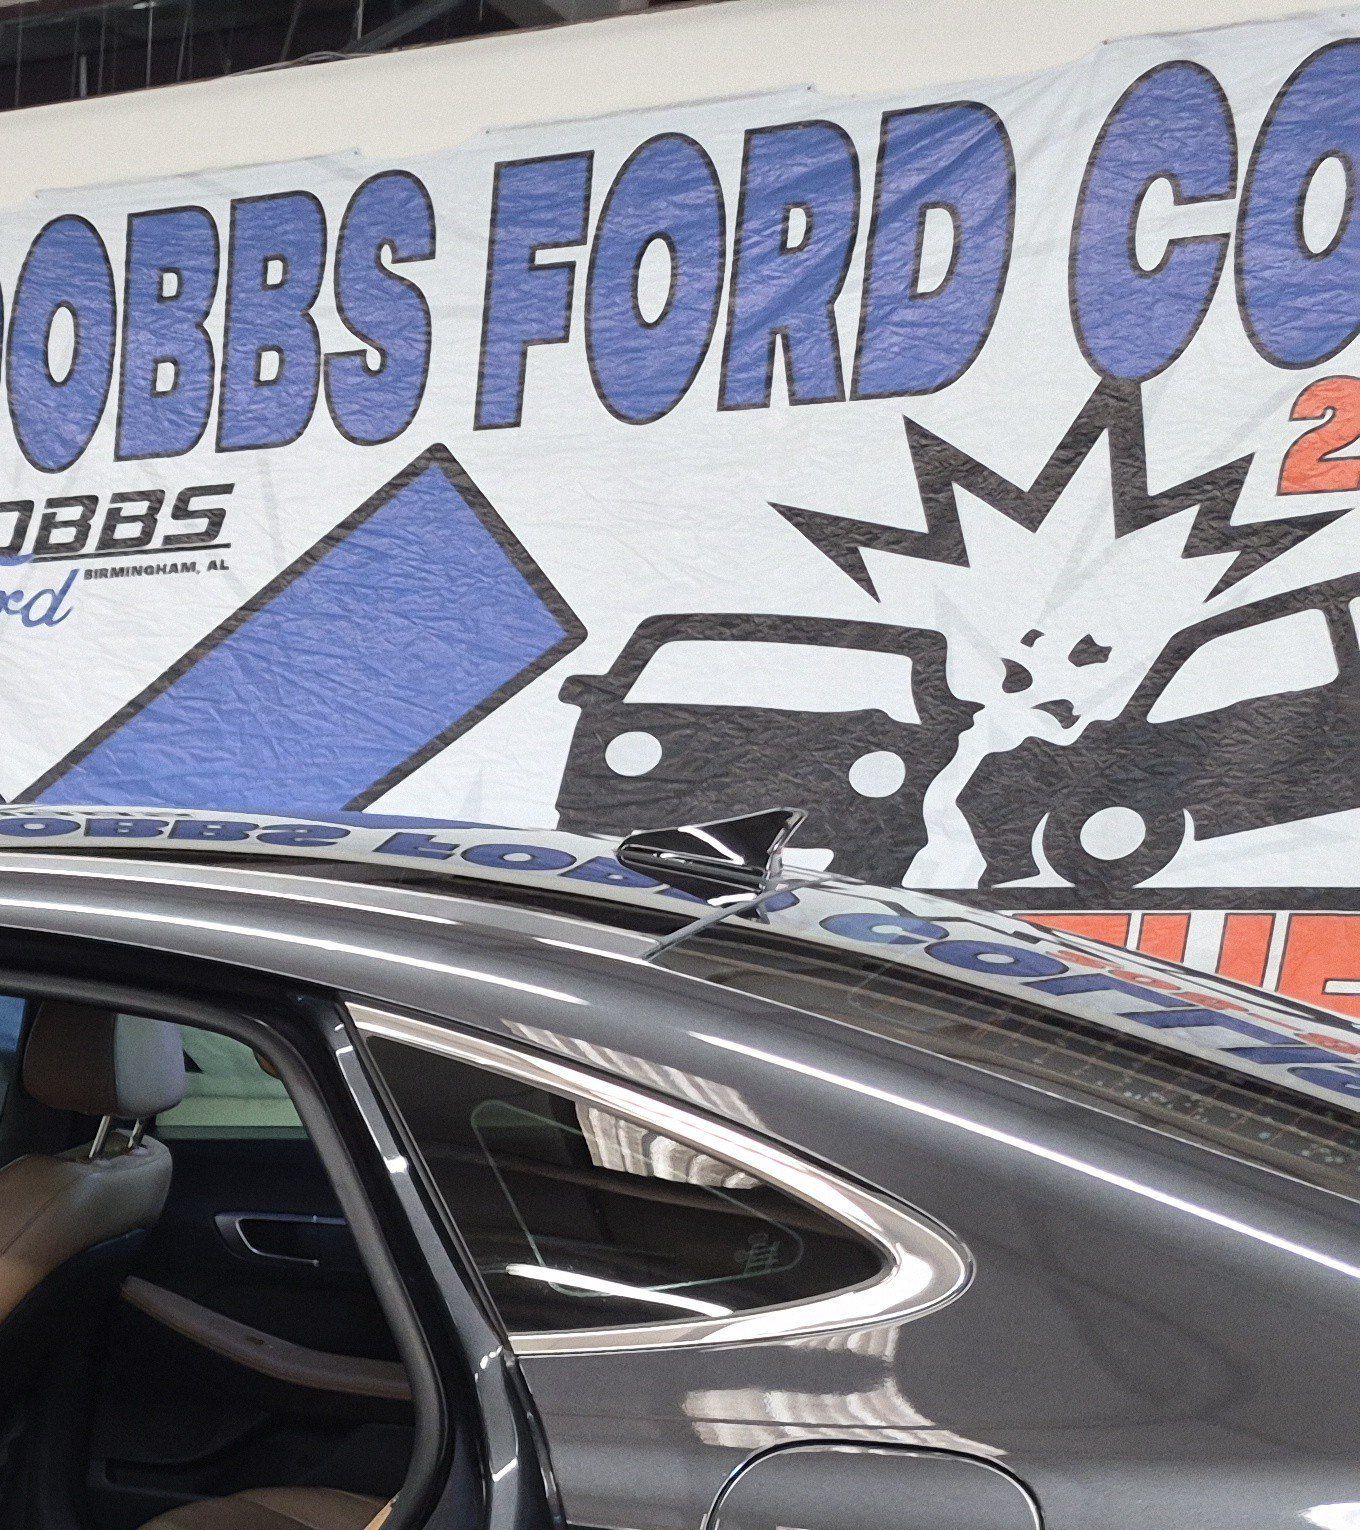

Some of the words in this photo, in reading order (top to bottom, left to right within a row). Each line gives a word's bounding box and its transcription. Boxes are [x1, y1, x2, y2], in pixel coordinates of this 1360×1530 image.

[476, 99, 1018, 431] FORD
[1067, 36, 1360, 384] CO
[84, 561, 201, 580] BIRMINGHAM,
[206, 559, 230, 572] AL
